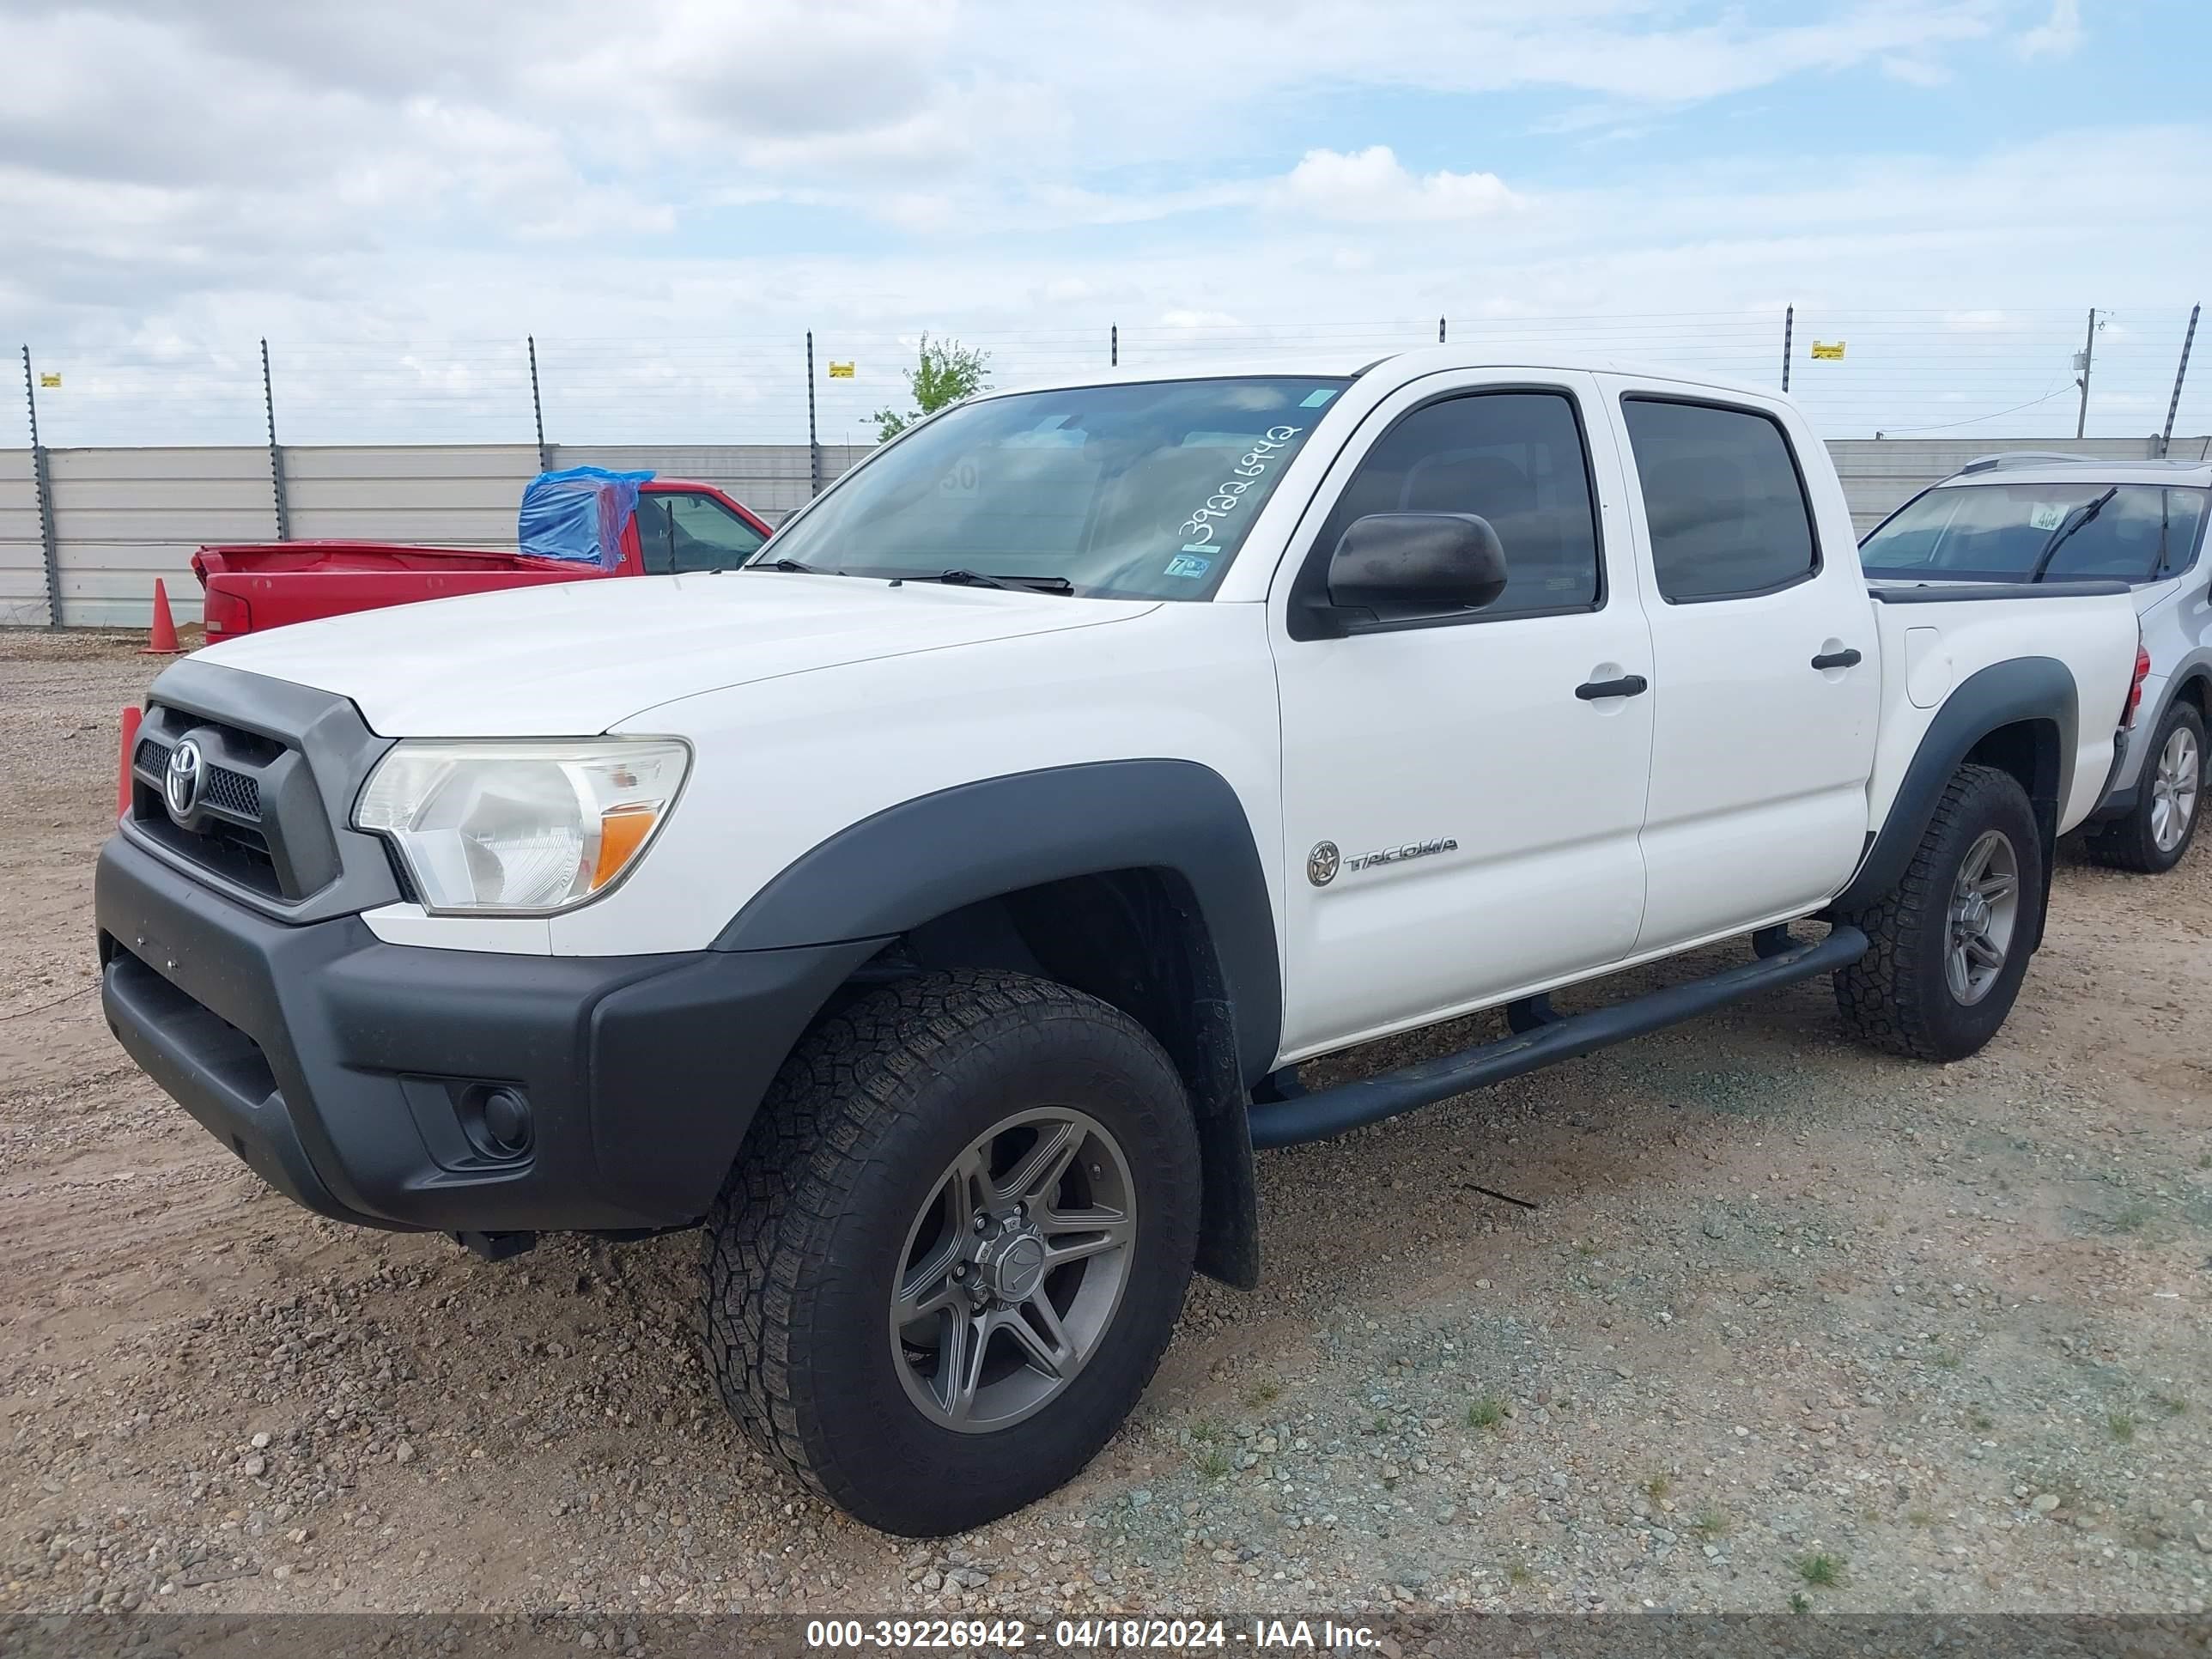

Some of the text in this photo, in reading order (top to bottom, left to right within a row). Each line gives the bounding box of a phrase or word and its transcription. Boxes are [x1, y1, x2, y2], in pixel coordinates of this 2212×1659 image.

[1179, 426, 1303, 545] 39226942
[1171, 559, 1185, 571] 7
[1343, 836, 1458, 872] TACOMA
